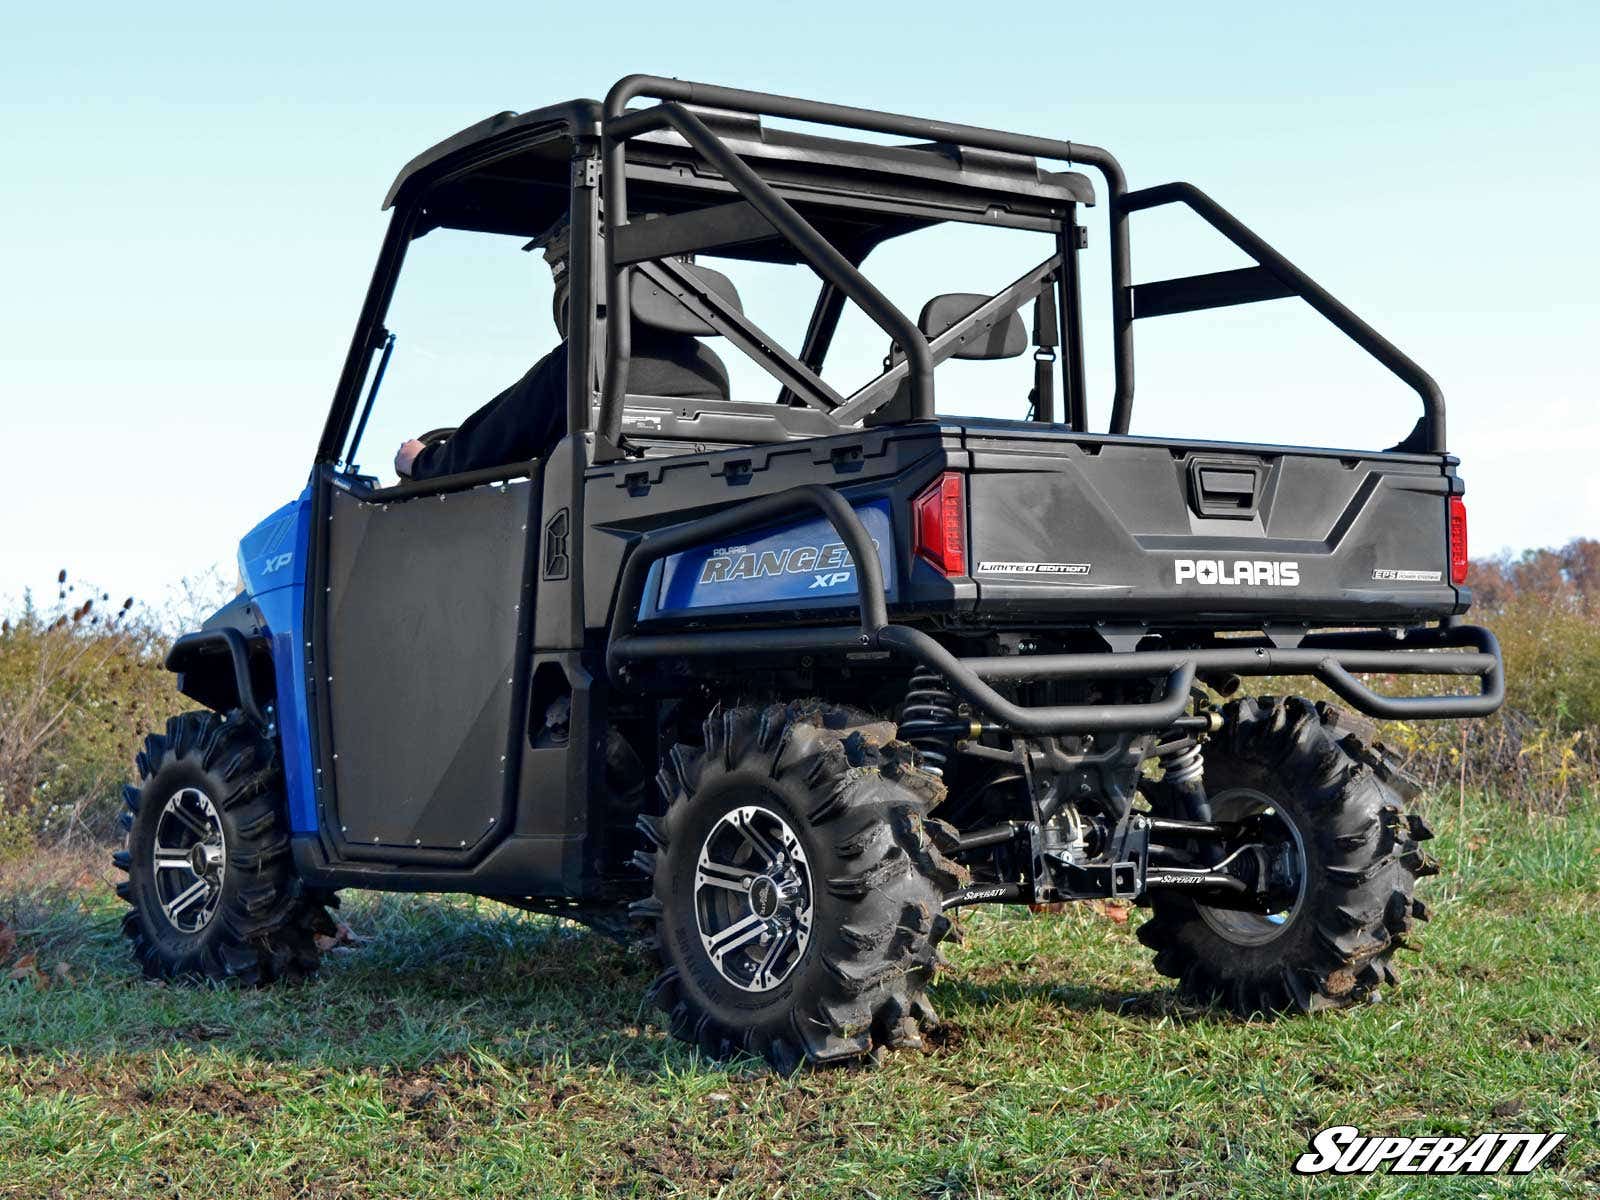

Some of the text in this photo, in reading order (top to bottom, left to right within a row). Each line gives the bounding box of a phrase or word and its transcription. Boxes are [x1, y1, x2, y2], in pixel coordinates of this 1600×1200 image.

[261, 552, 293, 576] XP
[699, 540, 879, 584] RANGE
[1174, 559, 1300, 586] POLARIS
[808, 572, 851, 588] XP
